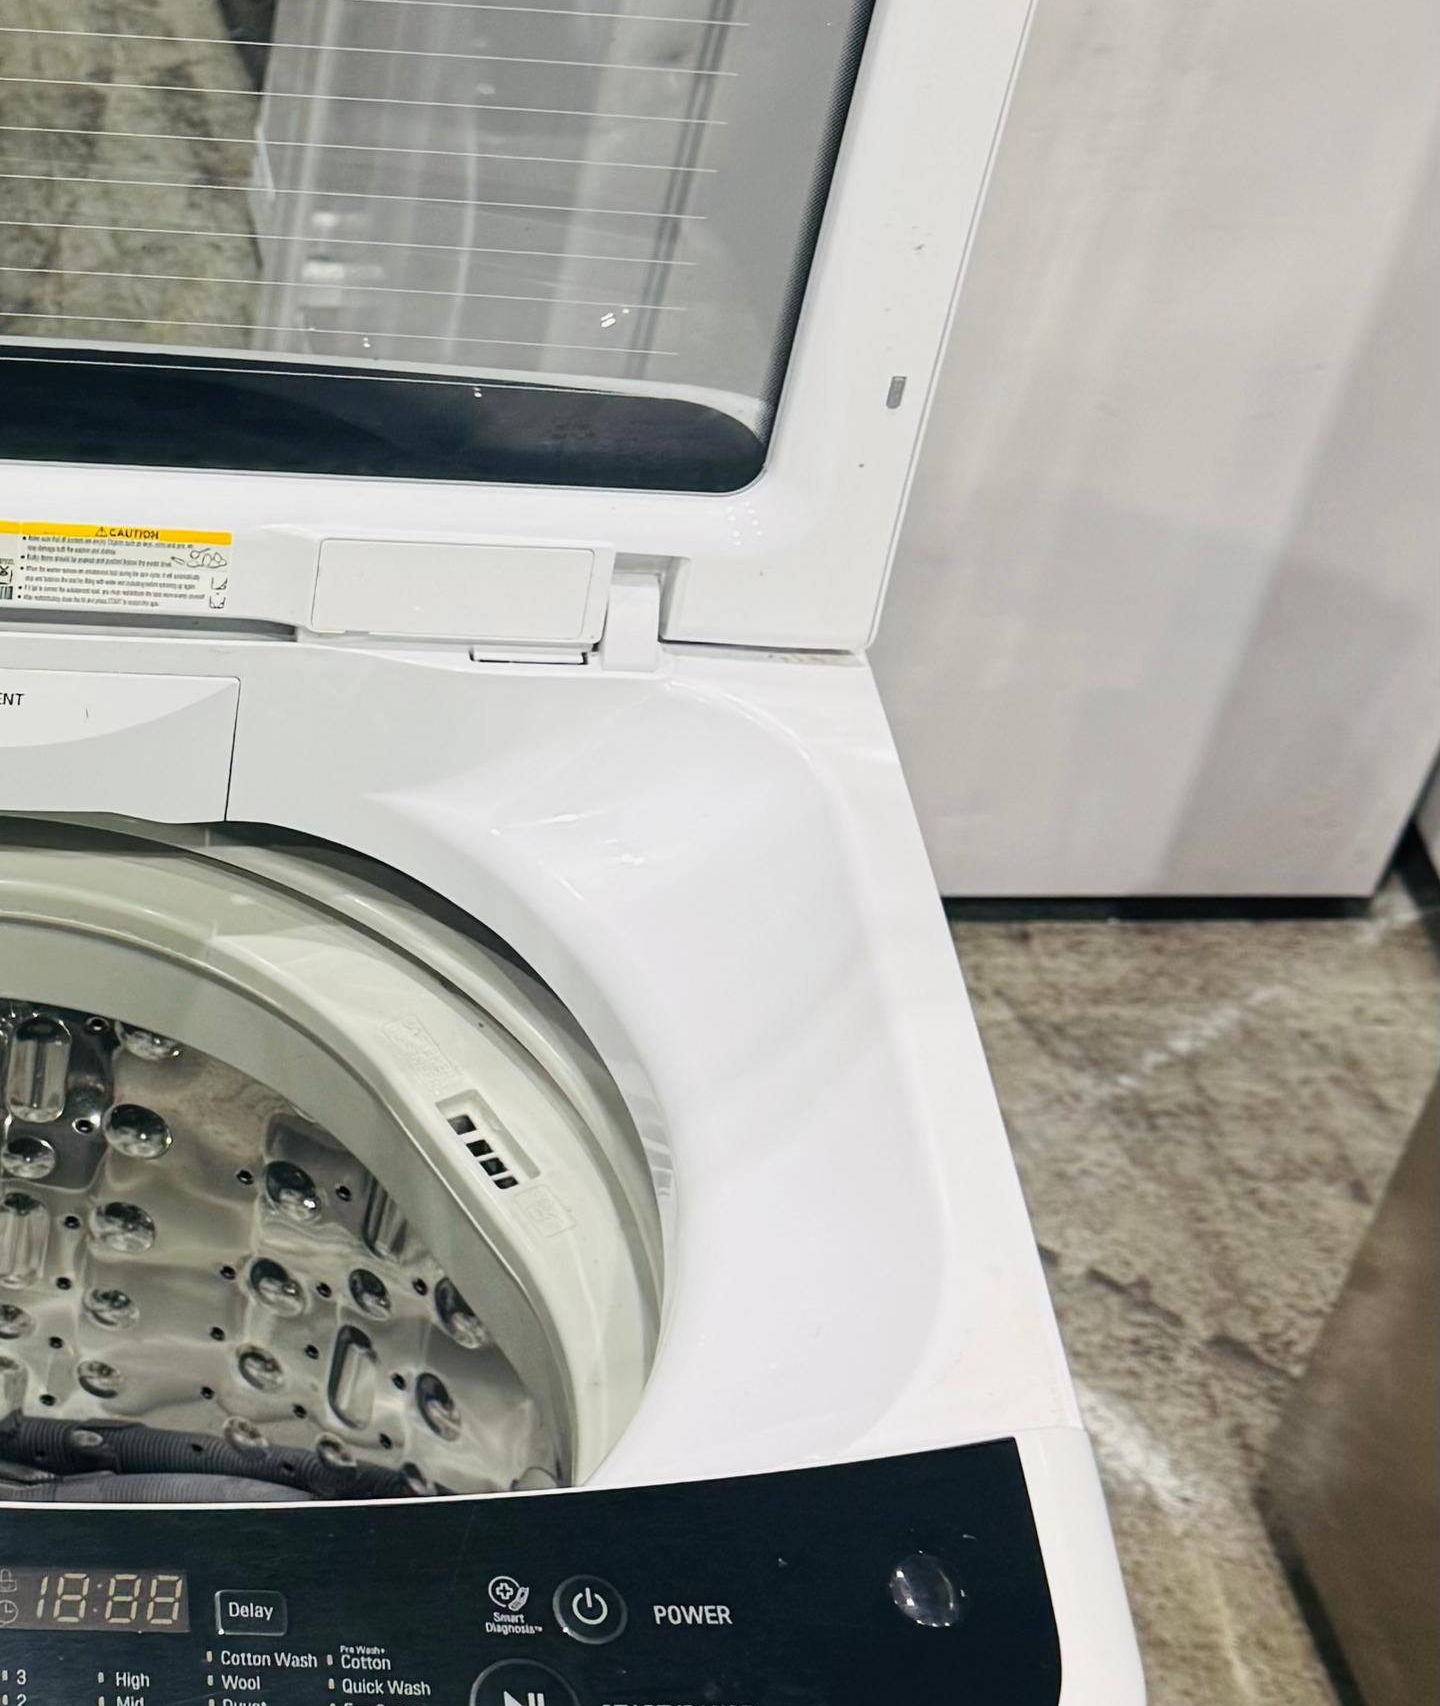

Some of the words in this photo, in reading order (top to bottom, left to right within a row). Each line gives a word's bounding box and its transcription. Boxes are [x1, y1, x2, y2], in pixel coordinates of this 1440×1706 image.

[109, 528, 160, 540] CAUTION
[228, 1601, 274, 1621] Delay
[493, 1612, 525, 1624] Smart
[654, 1605, 733, 1625] POWER
[220, 1650, 271, 1667] Cotton
[274, 1652, 318, 1668] Wash
[341, 1654, 391, 1670] Cotton
[16, 1669, 27, 1685] 3
[115, 1672, 150, 1690] High
[221, 1675, 261, 1691] Wool
[342, 1678, 384, 1695] Quick
[387, 1680, 431, 1696] Wash
